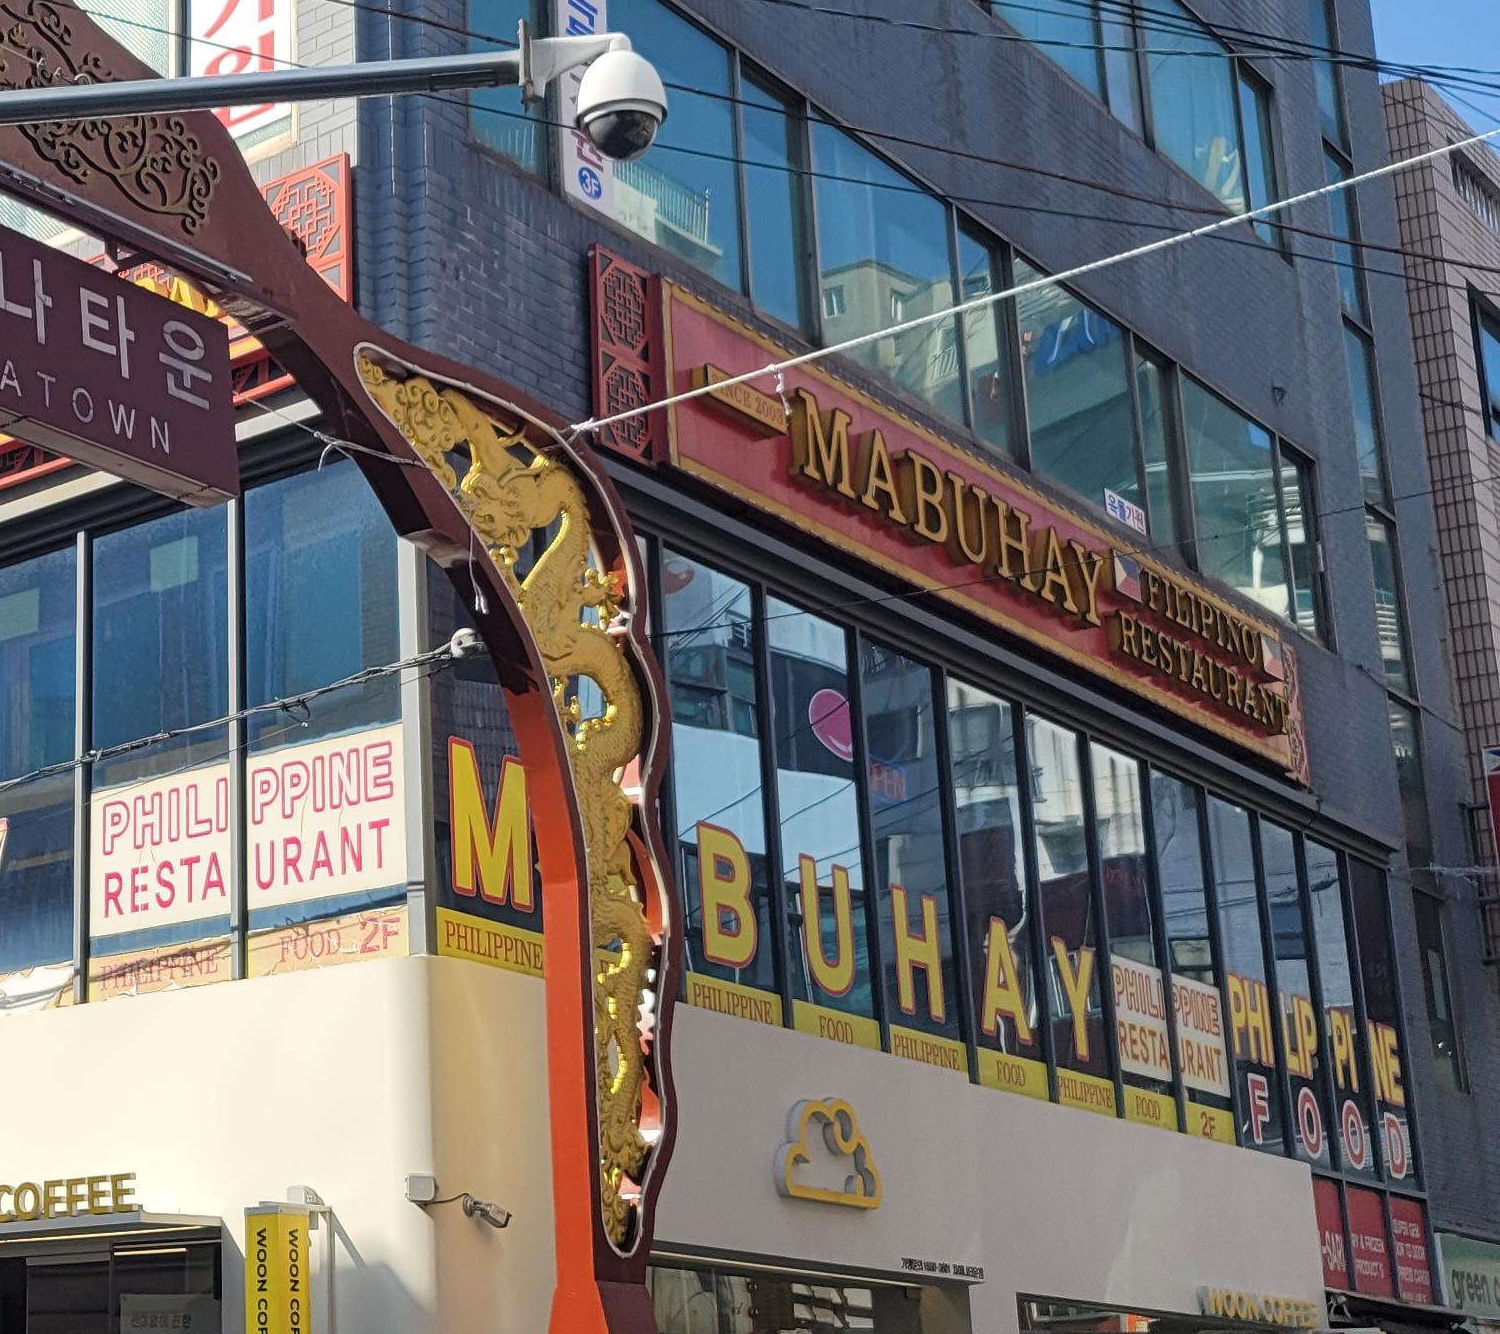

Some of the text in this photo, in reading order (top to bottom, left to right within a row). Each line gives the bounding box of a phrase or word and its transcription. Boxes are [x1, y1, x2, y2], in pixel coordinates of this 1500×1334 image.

[756, 395, 784, 424] 2003
[798, 387, 1102, 627] MABUHAY
[1107, 492, 1146, 536] 옥돌기원
[1146, 569, 1257, 664] FILIPINO
[1119, 611, 1289, 735] RESTAURANT
[100, 915, 401, 990] PHILIPPINE FOOD 2F
[443, 918, 542, 970] PHILIPPINE
[692, 981, 1216, 1139] PHILIPPINE FOOD PHILIPPINE FOOD PHILIPPINE FOOD 2F
[255, 1226, 269, 1294] WOON
[286, 1227, 300, 1294] WOON
[1452, 1269, 1491, 1309] green
[1207, 1288, 1323, 1329] WOON COFFEE
